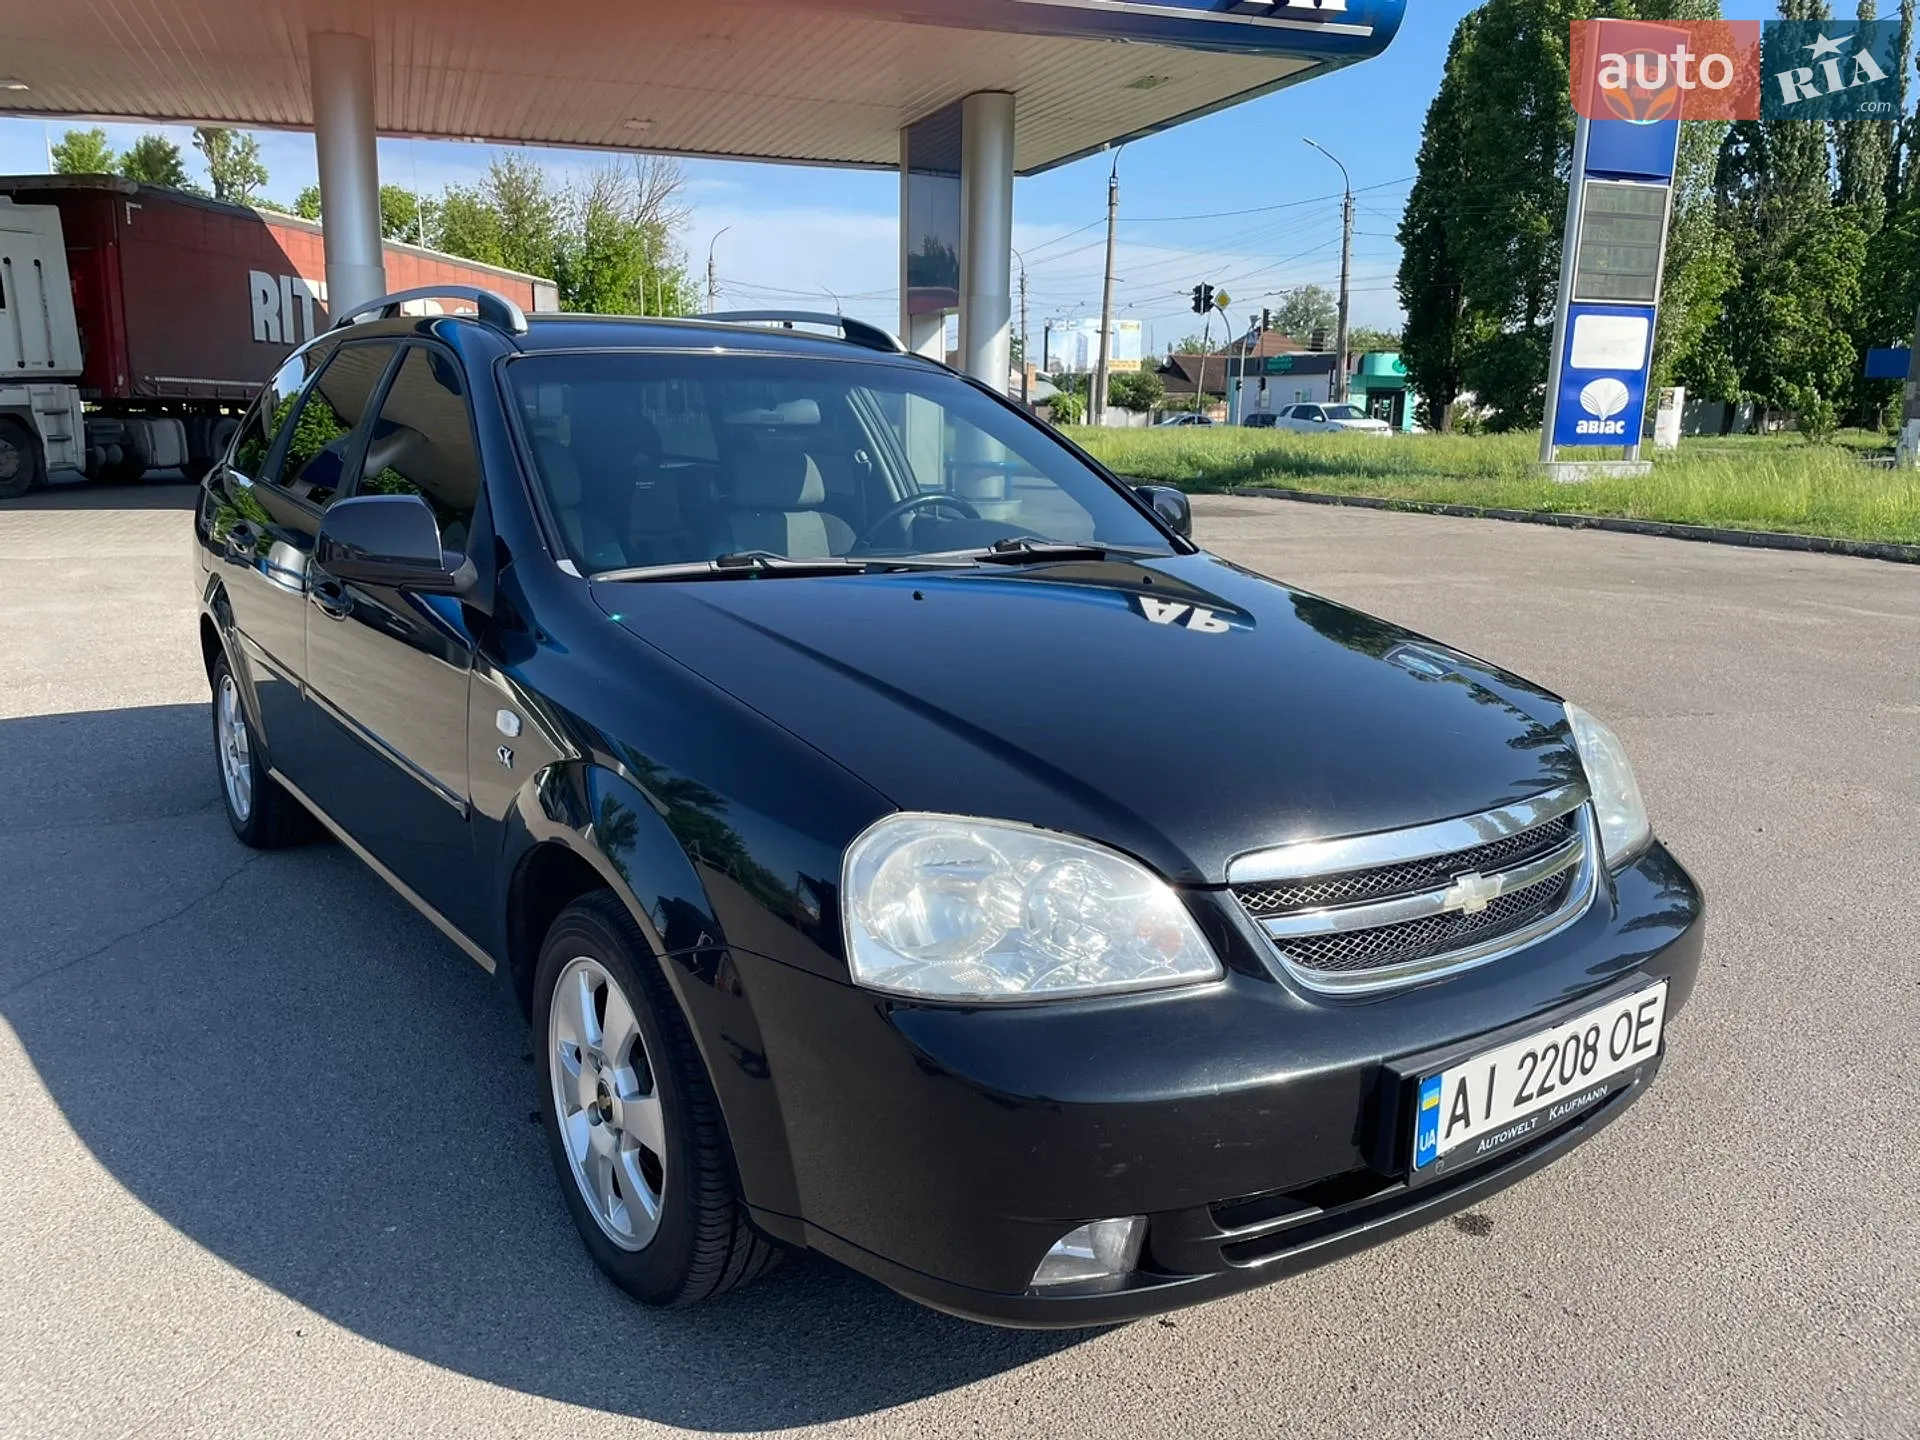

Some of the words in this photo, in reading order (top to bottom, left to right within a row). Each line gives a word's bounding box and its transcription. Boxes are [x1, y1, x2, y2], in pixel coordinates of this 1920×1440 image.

[1444, 1063, 1497, 1139] AI
[1513, 1023, 1601, 1108] 2208
[1609, 996, 1658, 1062] OE
[1419, 1128, 1437, 1152] UA
[1476, 1117, 1539, 1154] AUTOWELT
[1549, 1085, 1608, 1121] KAUFMANN
